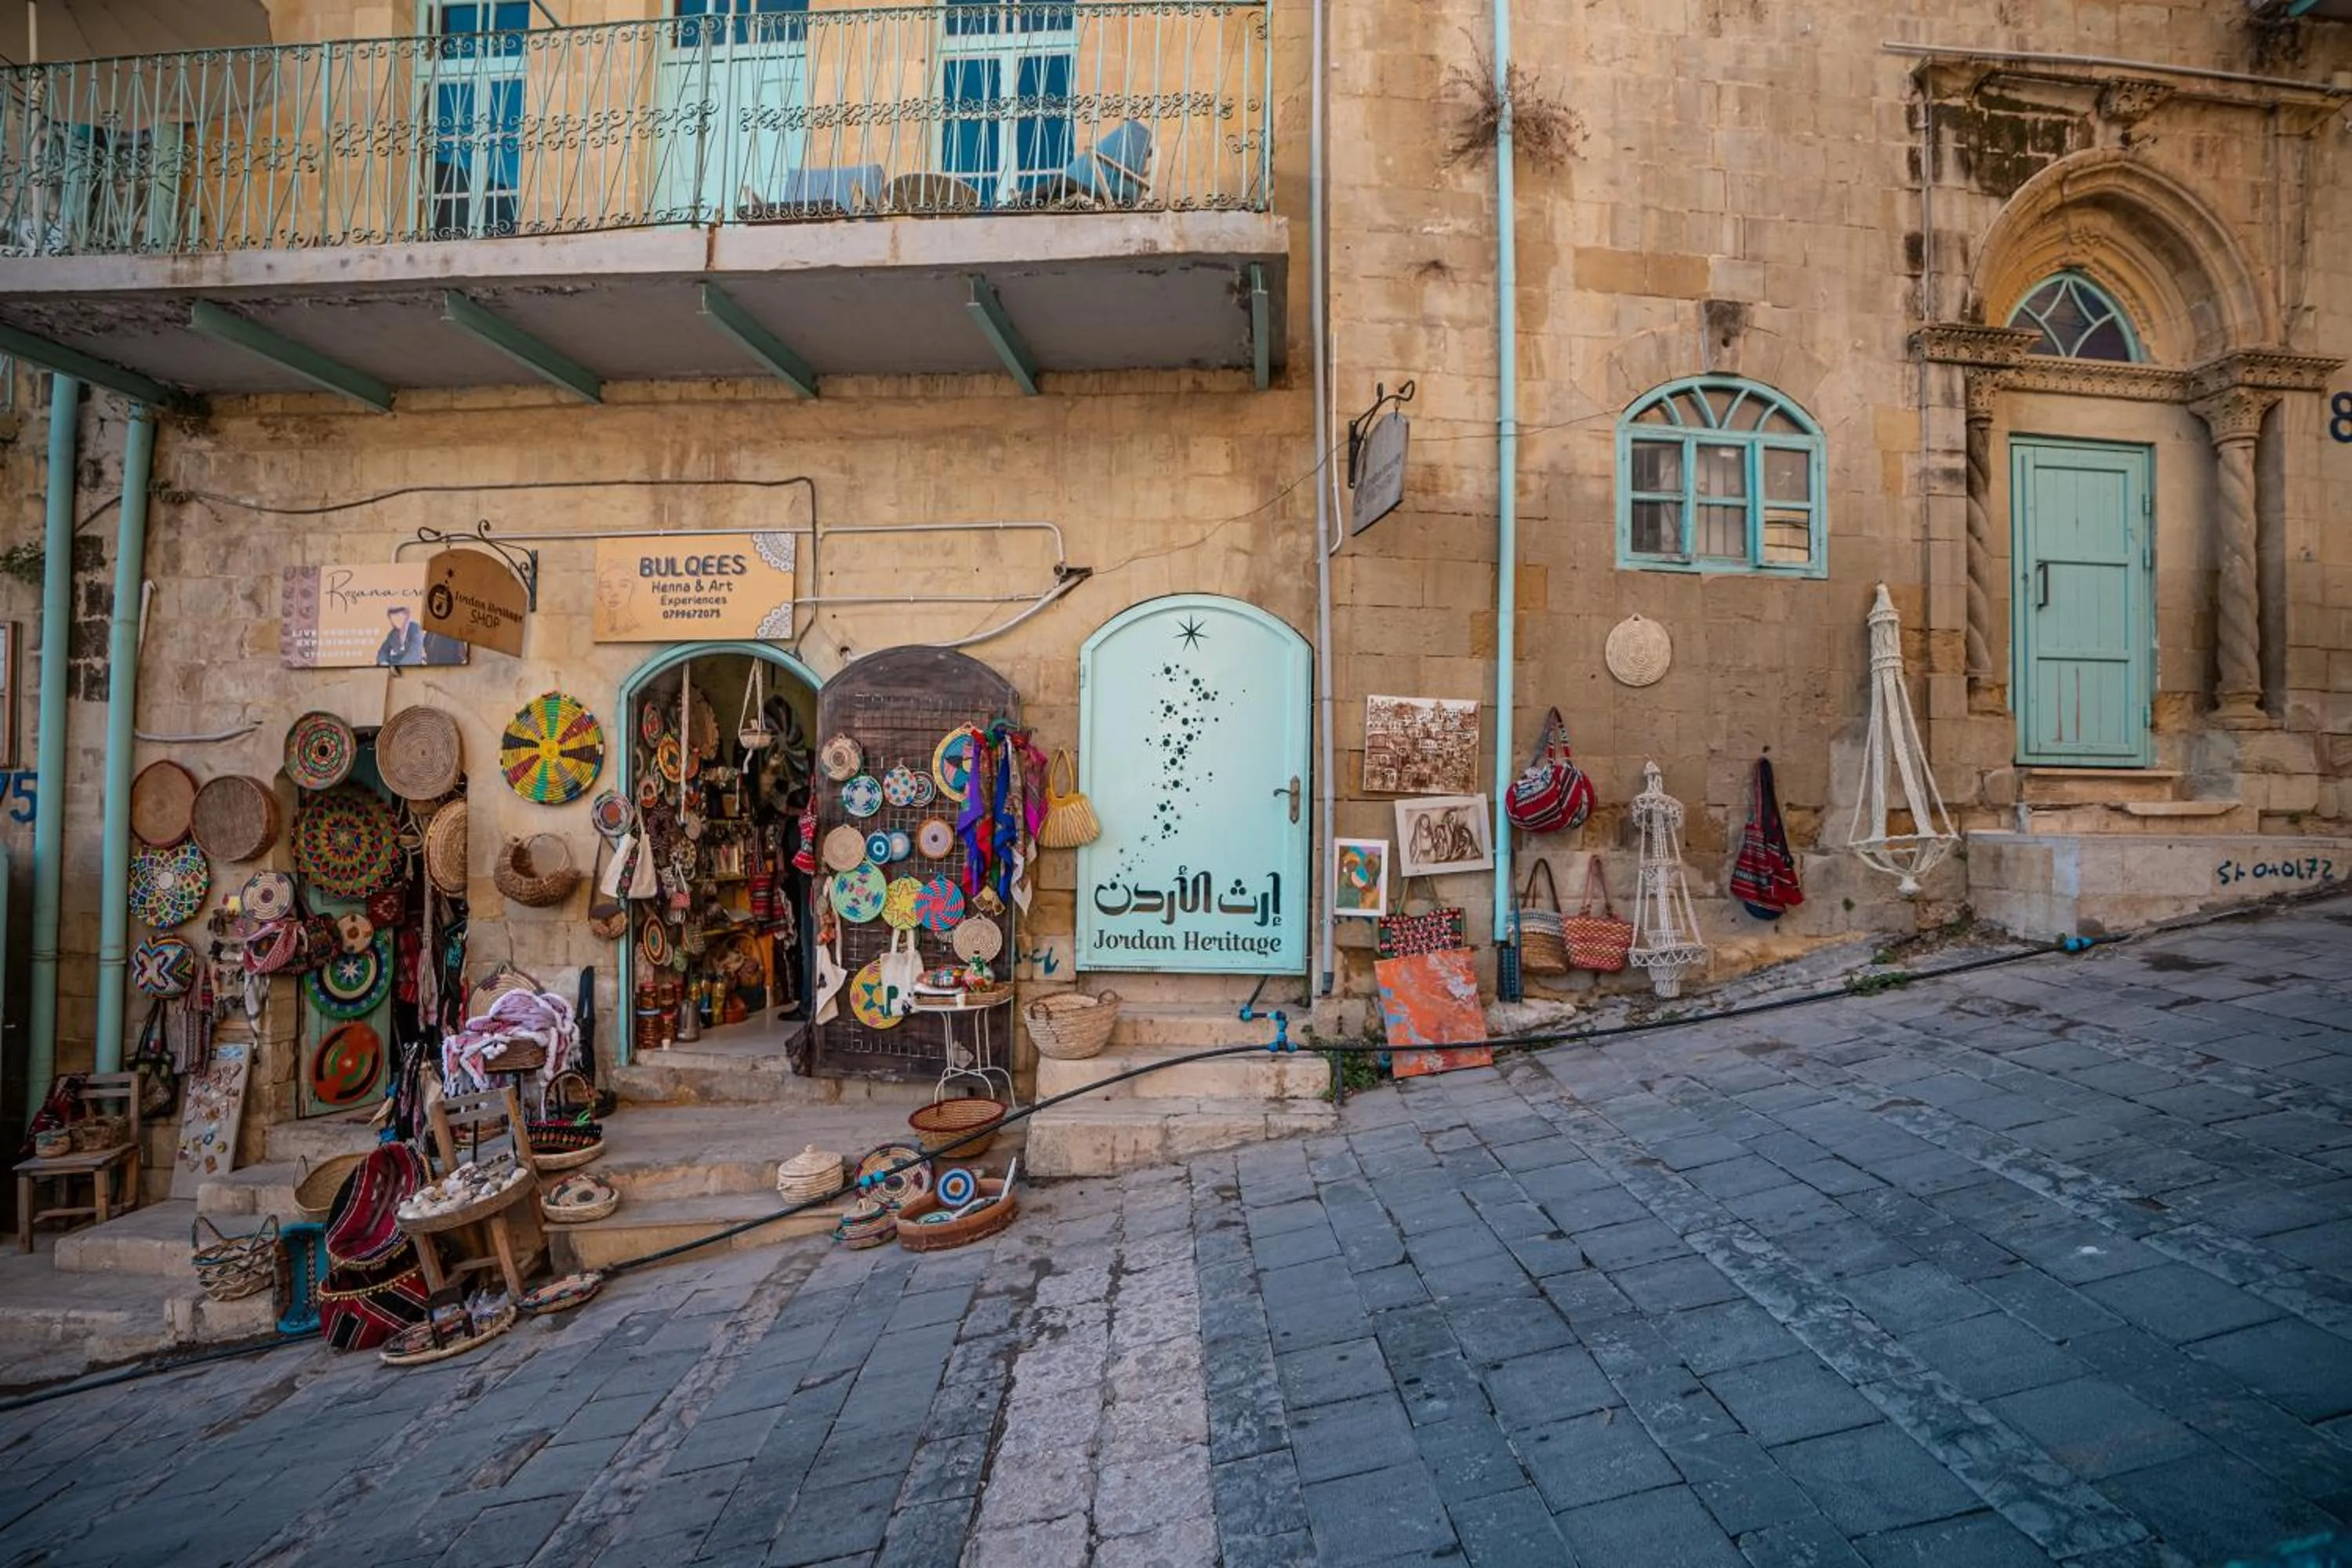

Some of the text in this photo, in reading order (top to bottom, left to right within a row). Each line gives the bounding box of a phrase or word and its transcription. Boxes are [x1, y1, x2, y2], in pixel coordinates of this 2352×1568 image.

[639, 554, 746, 578] BULQEES
[652, 579, 733, 593] Henna & Art
[660, 596, 727, 607] Experiences
[470, 609, 501, 629] SHOP
[1094, 865, 1282, 927] إرث الأردن
[1093, 929, 1282, 957] Jordan Heritage
